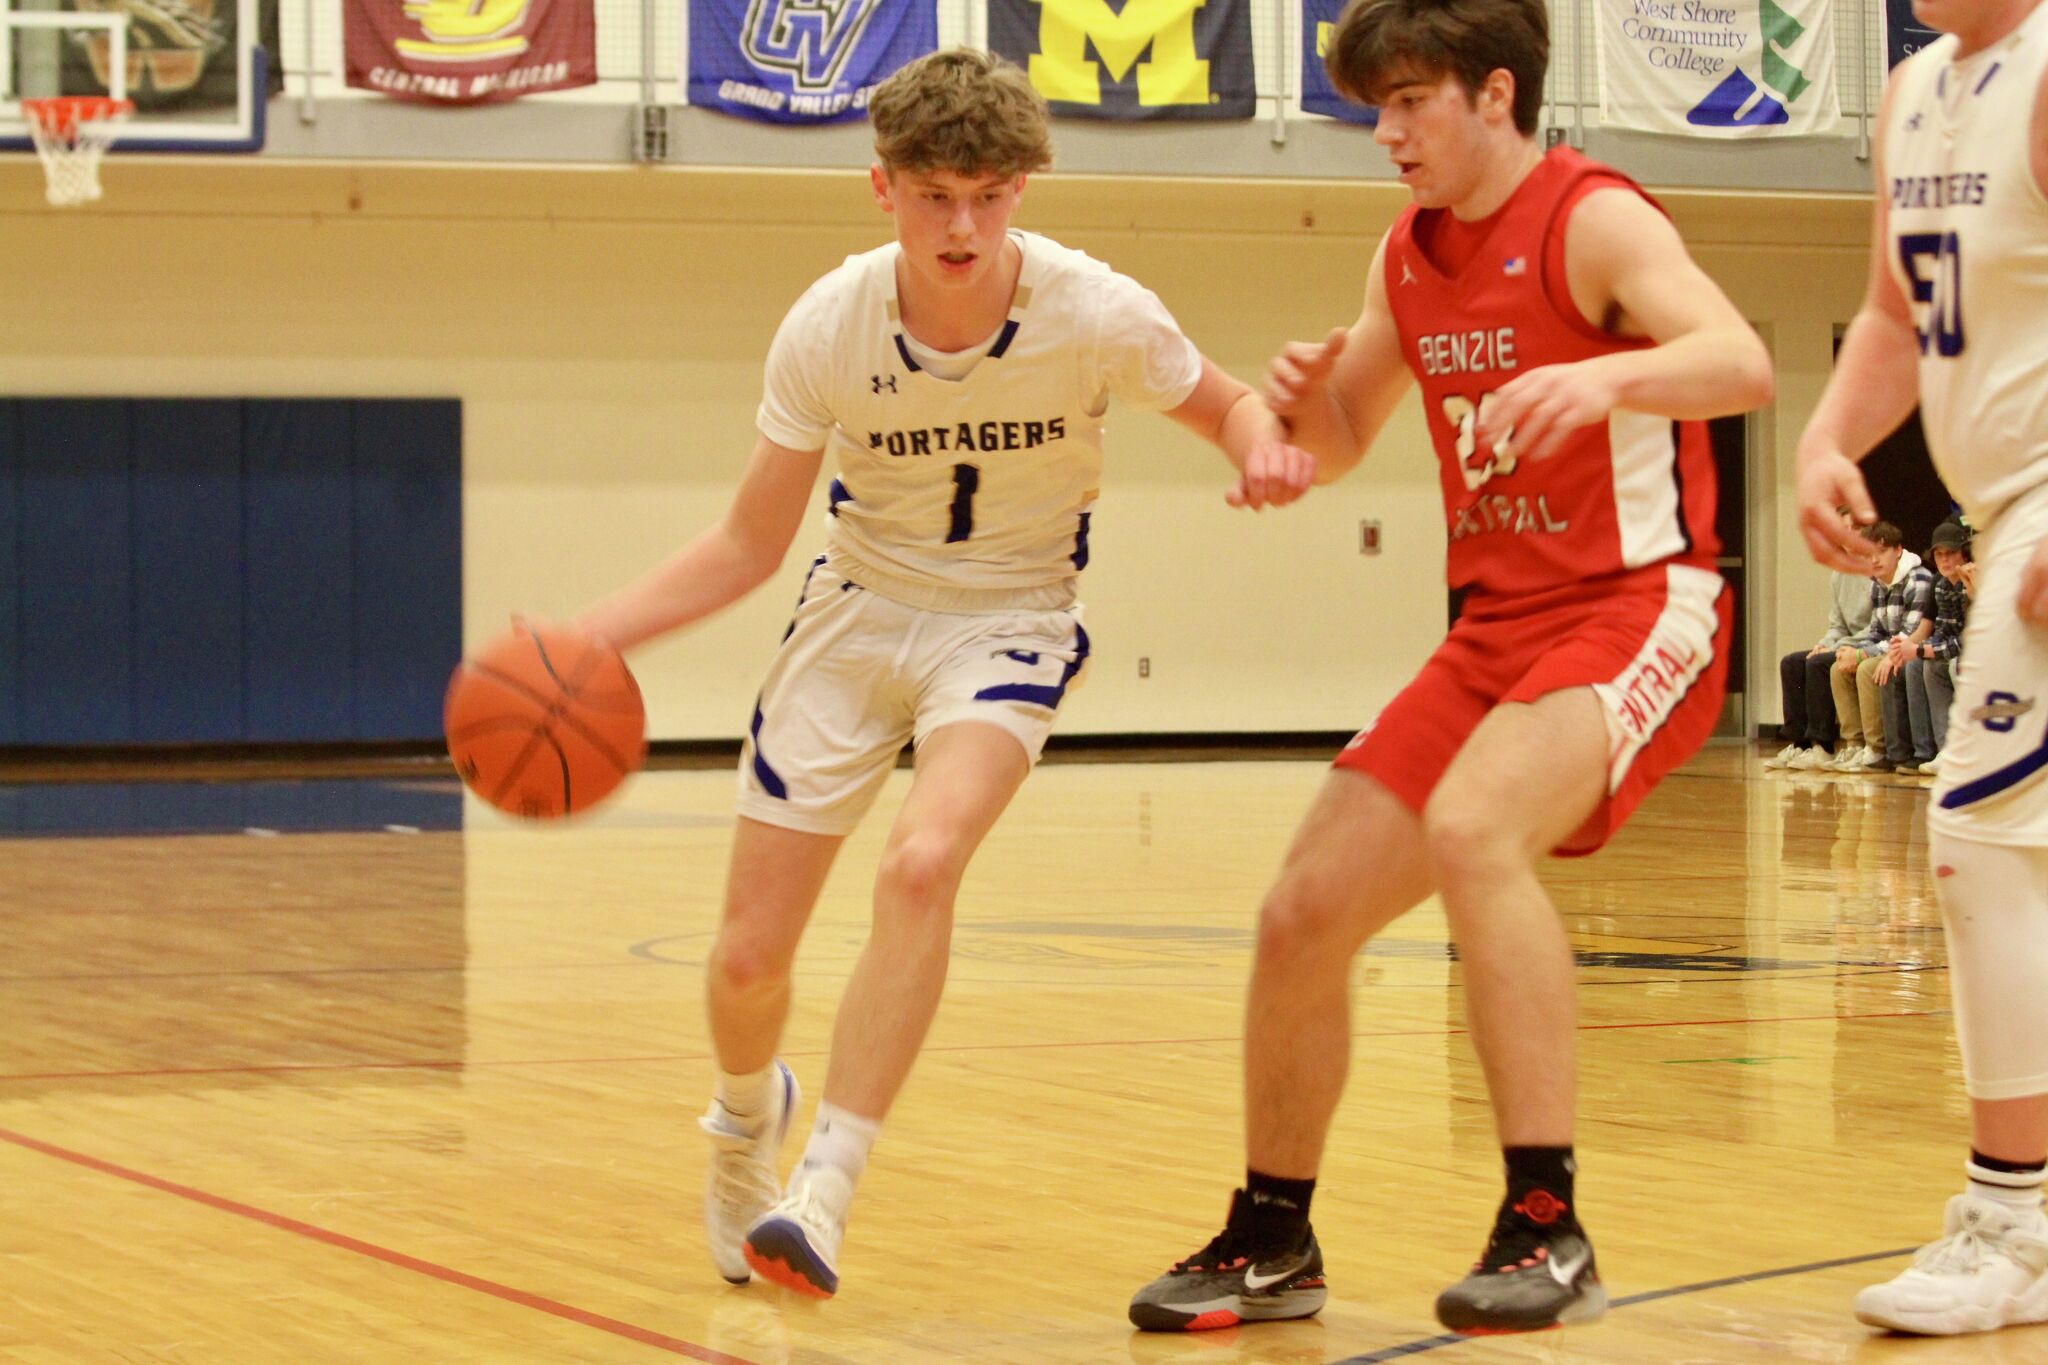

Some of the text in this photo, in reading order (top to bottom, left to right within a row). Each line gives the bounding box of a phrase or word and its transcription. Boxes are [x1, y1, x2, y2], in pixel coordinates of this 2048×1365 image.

[1633, 0, 1737, 25] West Shore
[1622, 17, 1748, 53] Community
[1027, 0, 1211, 107] M
[1648, 46, 1726, 77] College
[470, 61, 569, 95] MIHIGAN
[717, 79, 786, 111] GRAND
[1898, 231, 1966, 358] 50
[1417, 326, 1518, 376] BENZIE
[944, 463, 982, 545] 1
